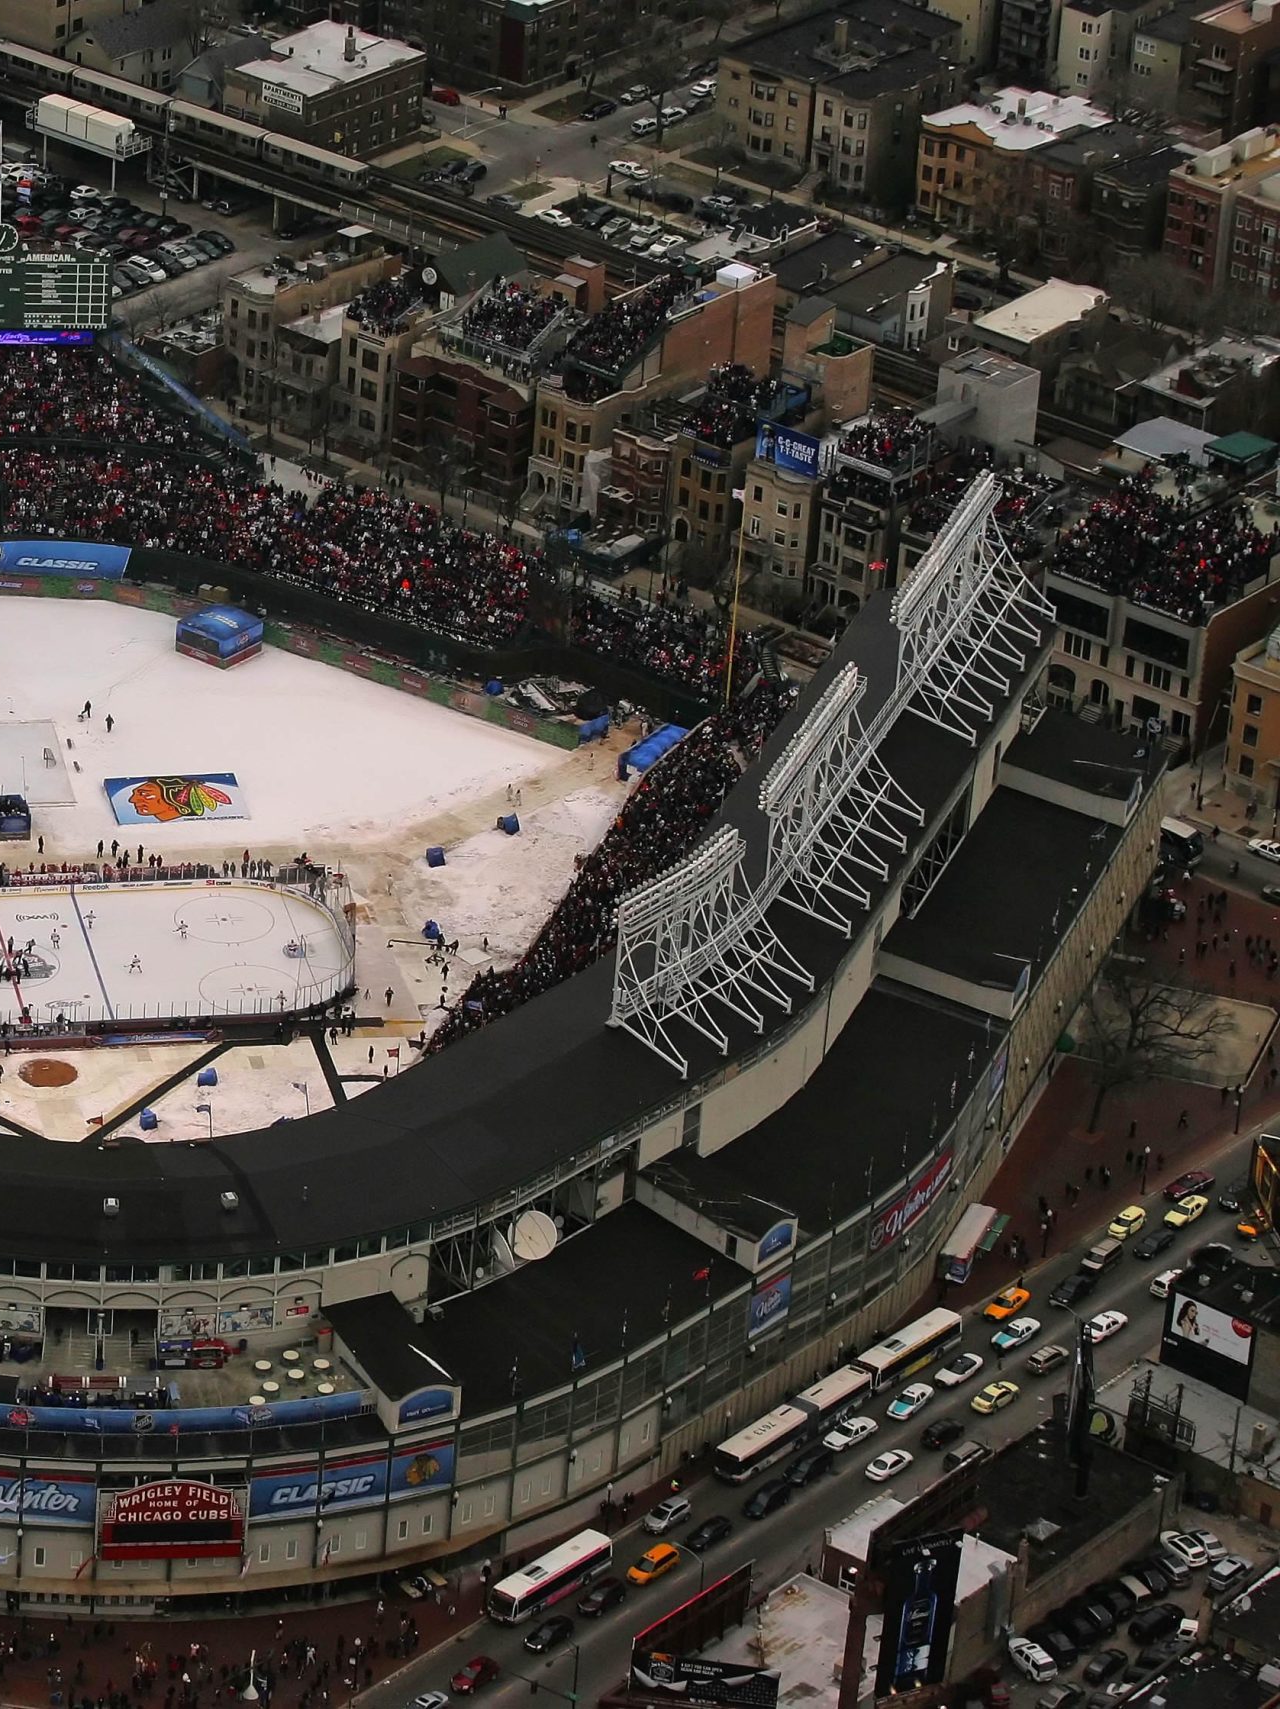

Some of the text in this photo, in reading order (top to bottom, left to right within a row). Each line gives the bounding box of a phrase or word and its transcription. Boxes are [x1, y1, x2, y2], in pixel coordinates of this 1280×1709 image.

[25, 253, 72, 263] AMERICAN
[16, 556, 98, 571] CLASSIC
[82, 883, 111, 891] Reebok
[753, 1421, 777, 1436] 7613
[119, 1485, 229, 1509] WRIGLEY FIELD
[149, 1499, 200, 1508] HOME OF
[118, 1509, 229, 1522] CHICAGO CUBS
